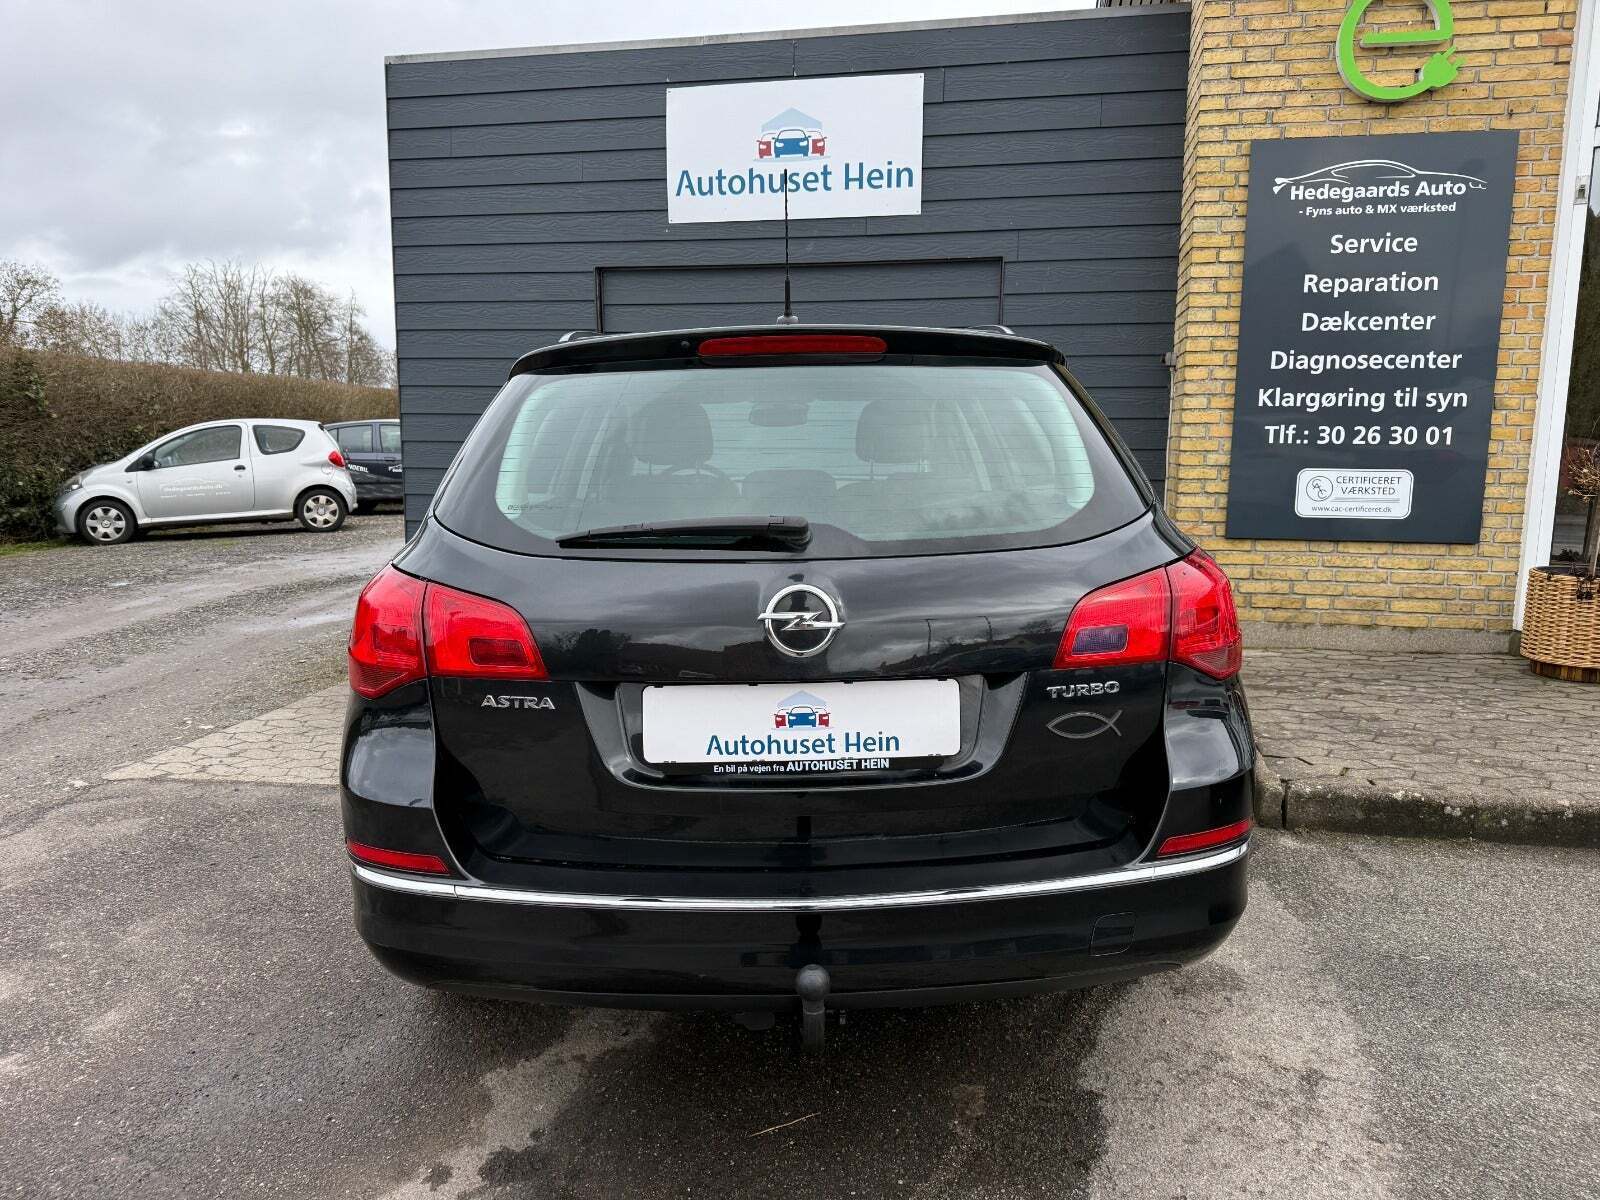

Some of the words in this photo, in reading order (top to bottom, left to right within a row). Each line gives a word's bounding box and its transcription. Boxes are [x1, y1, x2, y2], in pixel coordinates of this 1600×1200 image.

[676, 164, 832, 197] Autohuset
[845, 161, 913, 190] Hein
[1290, 181, 1409, 202] Hedegaards
[1415, 181, 1466, 196] Auto
[1306, 206, 1332, 218] Fyns
[1335, 205, 1362, 215] auto
[1366, 204, 1374, 214] &
[1377, 204, 1397, 214] MX
[1400, 202, 1456, 213] værksted
[1330, 232, 1418, 254] Service
[1303, 272, 1439, 297] Reparation
[1302, 311, 1436, 332] Dækcenter
[1270, 350, 1462, 375] Diagnosecenter
[1258, 388, 1385, 412] Klargøring
[1394, 388, 1417, 407] til
[1426, 392, 1468, 412] syn
[1264, 425, 1309, 444] Tlf.:
[1317, 426, 1345, 445] 30
[1352, 426, 1381, 445] 26
[1389, 426, 1418, 445] 30
[1425, 427, 1453, 445] 01
[1336, 476, 1402, 484] CERTIFICERET
[1341, 487, 1395, 495] VÆRKSTED
[1046, 681, 1121, 698] TURBO
[481, 694, 556, 709] ASTRA
[706, 733, 835, 755] Autohuset
[844, 731, 900, 753] Hein
[726, 764, 736, 772] bil
[737, 764, 747, 774] på
[750, 764, 771, 774] vejen
[786, 760, 858, 771] AUTOHUSET
[862, 758, 889, 770] HEIN
